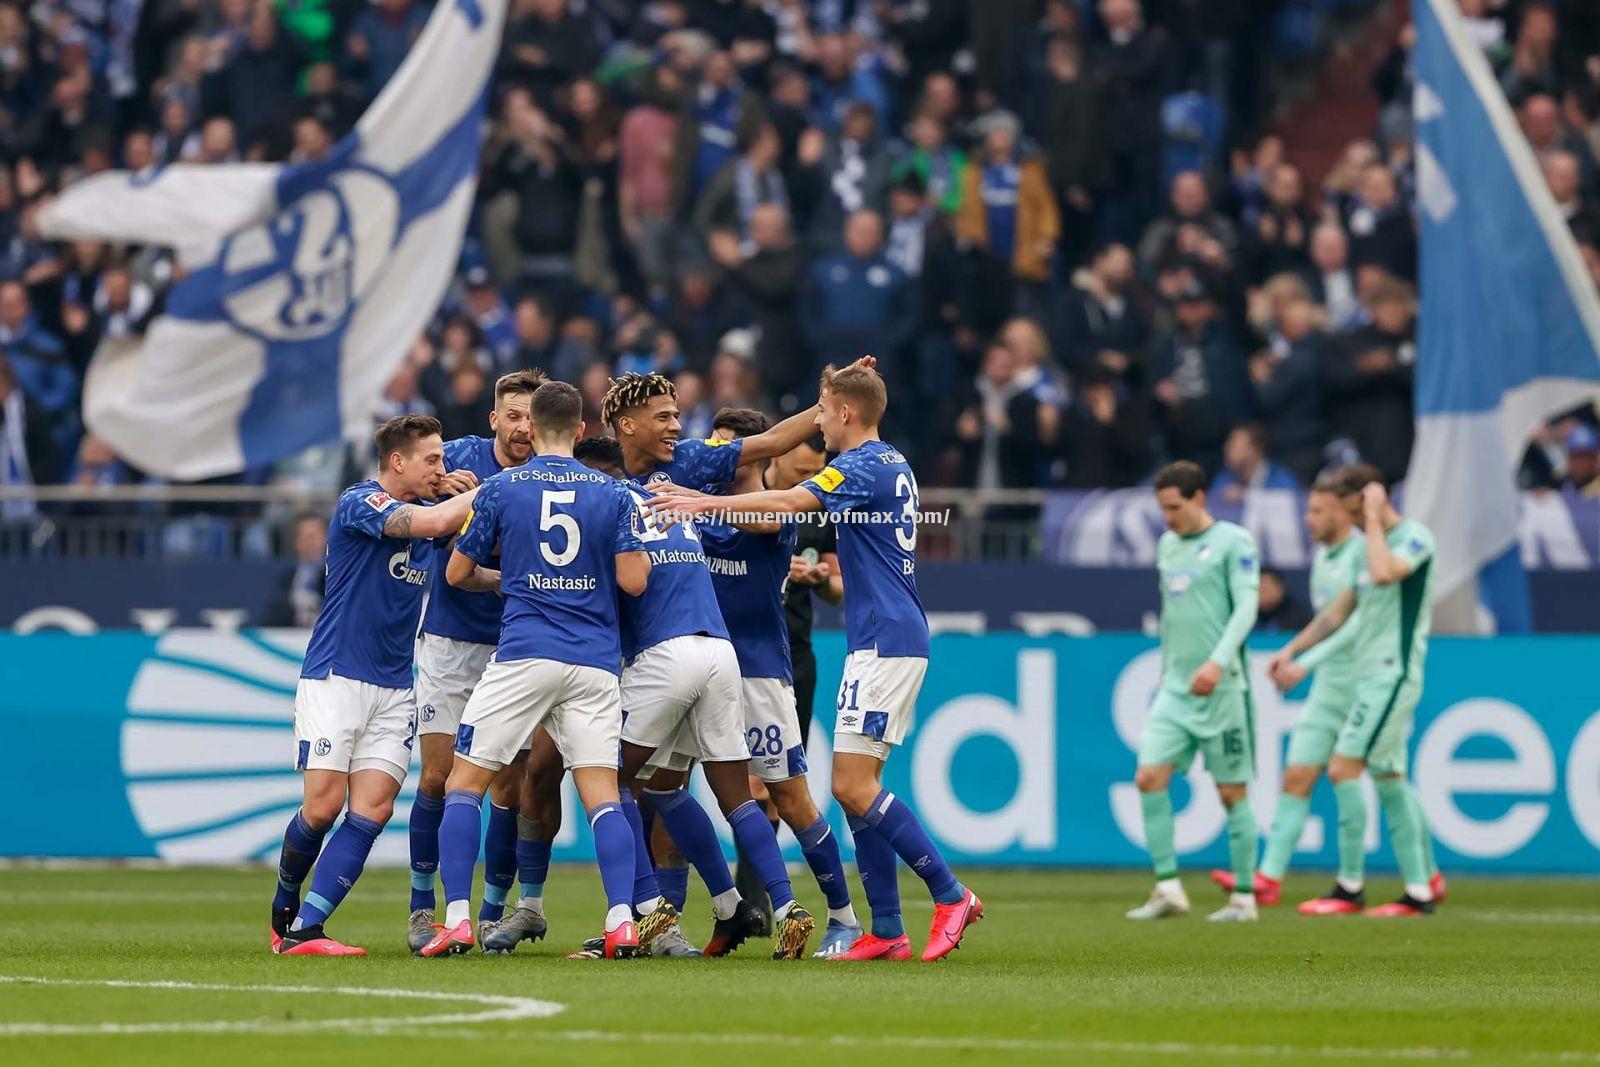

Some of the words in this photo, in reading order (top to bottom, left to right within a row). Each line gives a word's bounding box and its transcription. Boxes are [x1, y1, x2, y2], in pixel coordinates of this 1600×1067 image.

[511, 470, 529, 482] FC
[532, 469, 588, 483] Schalke
[589, 473, 606, 484] 04
[895, 470, 919, 552] 3
[539, 490, 580, 567] 5
[528, 573, 596, 590] Nastasic
[837, 679, 860, 711] 31
[748, 724, 784, 757] 28
[1222, 728, 1243, 757] 16
